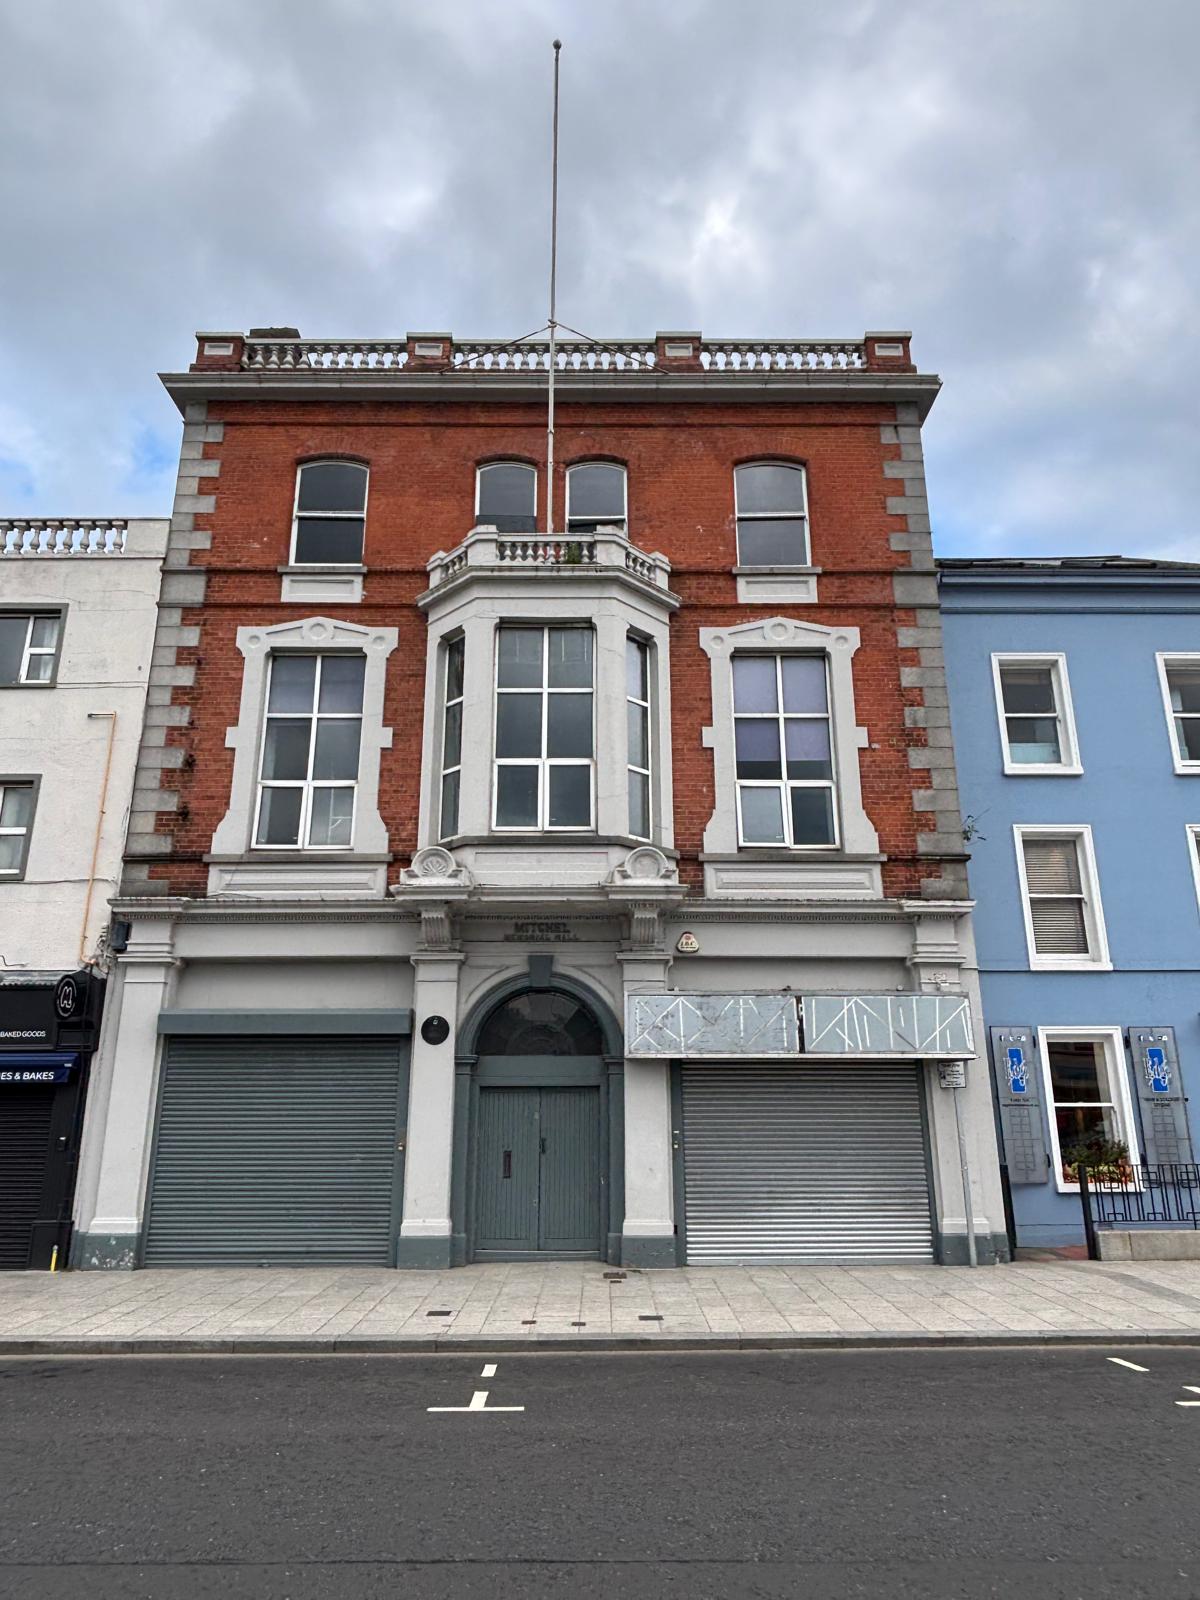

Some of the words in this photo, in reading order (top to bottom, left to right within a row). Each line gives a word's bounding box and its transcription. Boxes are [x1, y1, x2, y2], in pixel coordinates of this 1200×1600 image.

[0, 1030, 21, 1038] BAKED
[22, 1030, 46, 1038] GOODS
[0, 1071, 13, 1080] ES
[14, 1071, 21, 1080] &
[23, 1071, 54, 1080] BAKES
